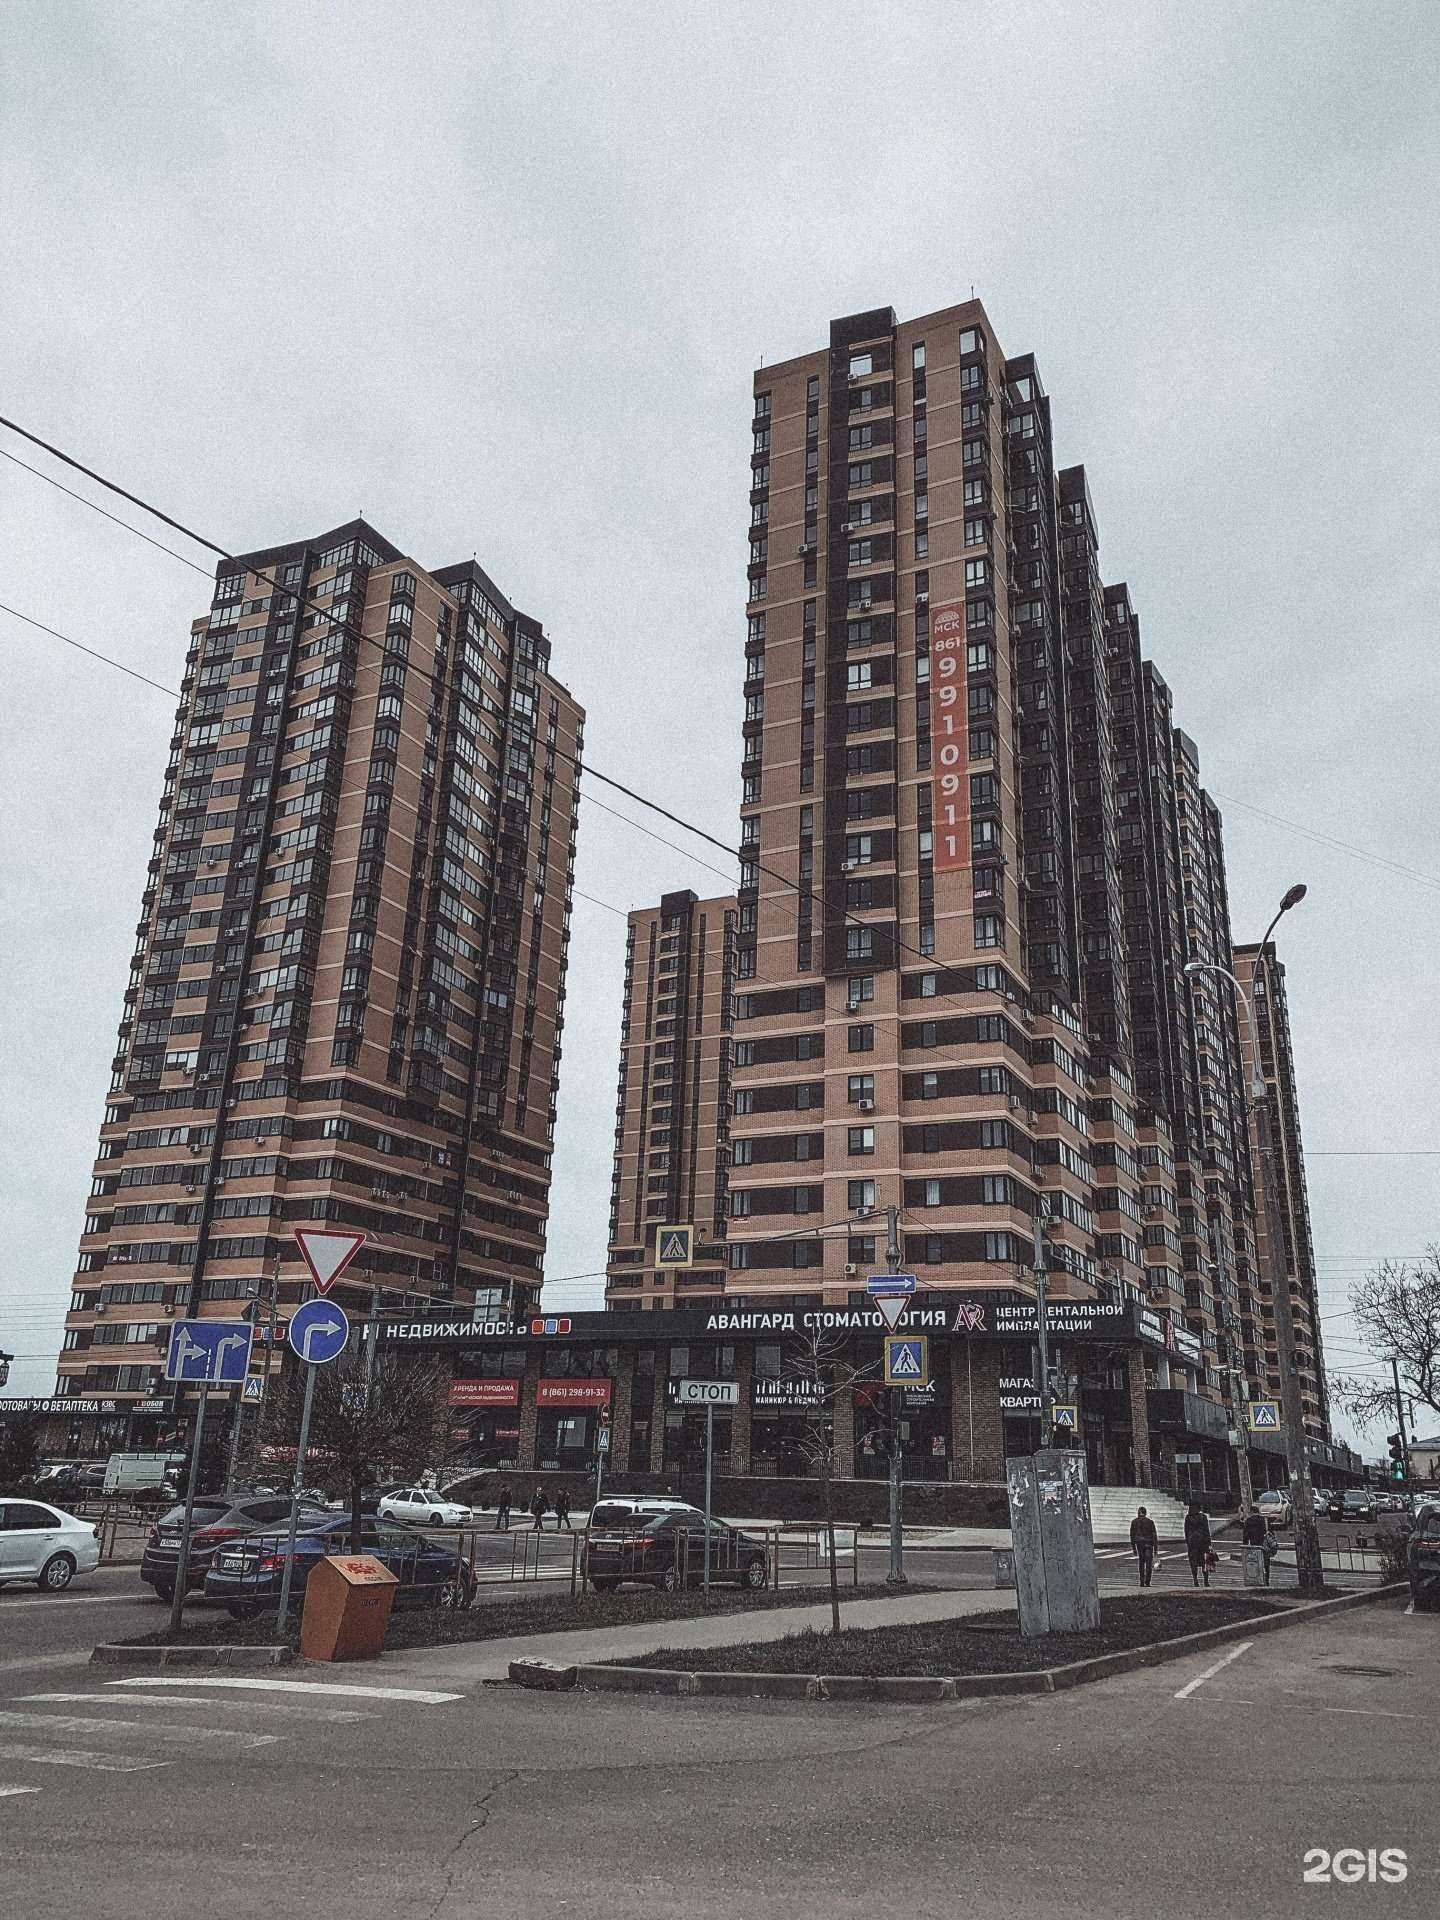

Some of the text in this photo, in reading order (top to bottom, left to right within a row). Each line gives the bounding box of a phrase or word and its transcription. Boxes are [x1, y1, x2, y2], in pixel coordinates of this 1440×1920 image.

[934, 620, 960, 634] МСК
[935, 637, 961, 652] 861
[996, 1305, 1124, 1318] ЦЕНТР ЕНТАЛЬНОЙ
[707, 1310, 947, 1331] АВАНГАРД СТОМАТООГИЯ
[549, 1388, 568, 1398] (861)
[569, 1388, 605, 1397] 298-91-32
[687, 1384, 731, 1400] СТОП
[51, 1400, 98, 1412] ВЕТАПТЕКА
[755, 1396, 786, 1404] МАНИКЮР
